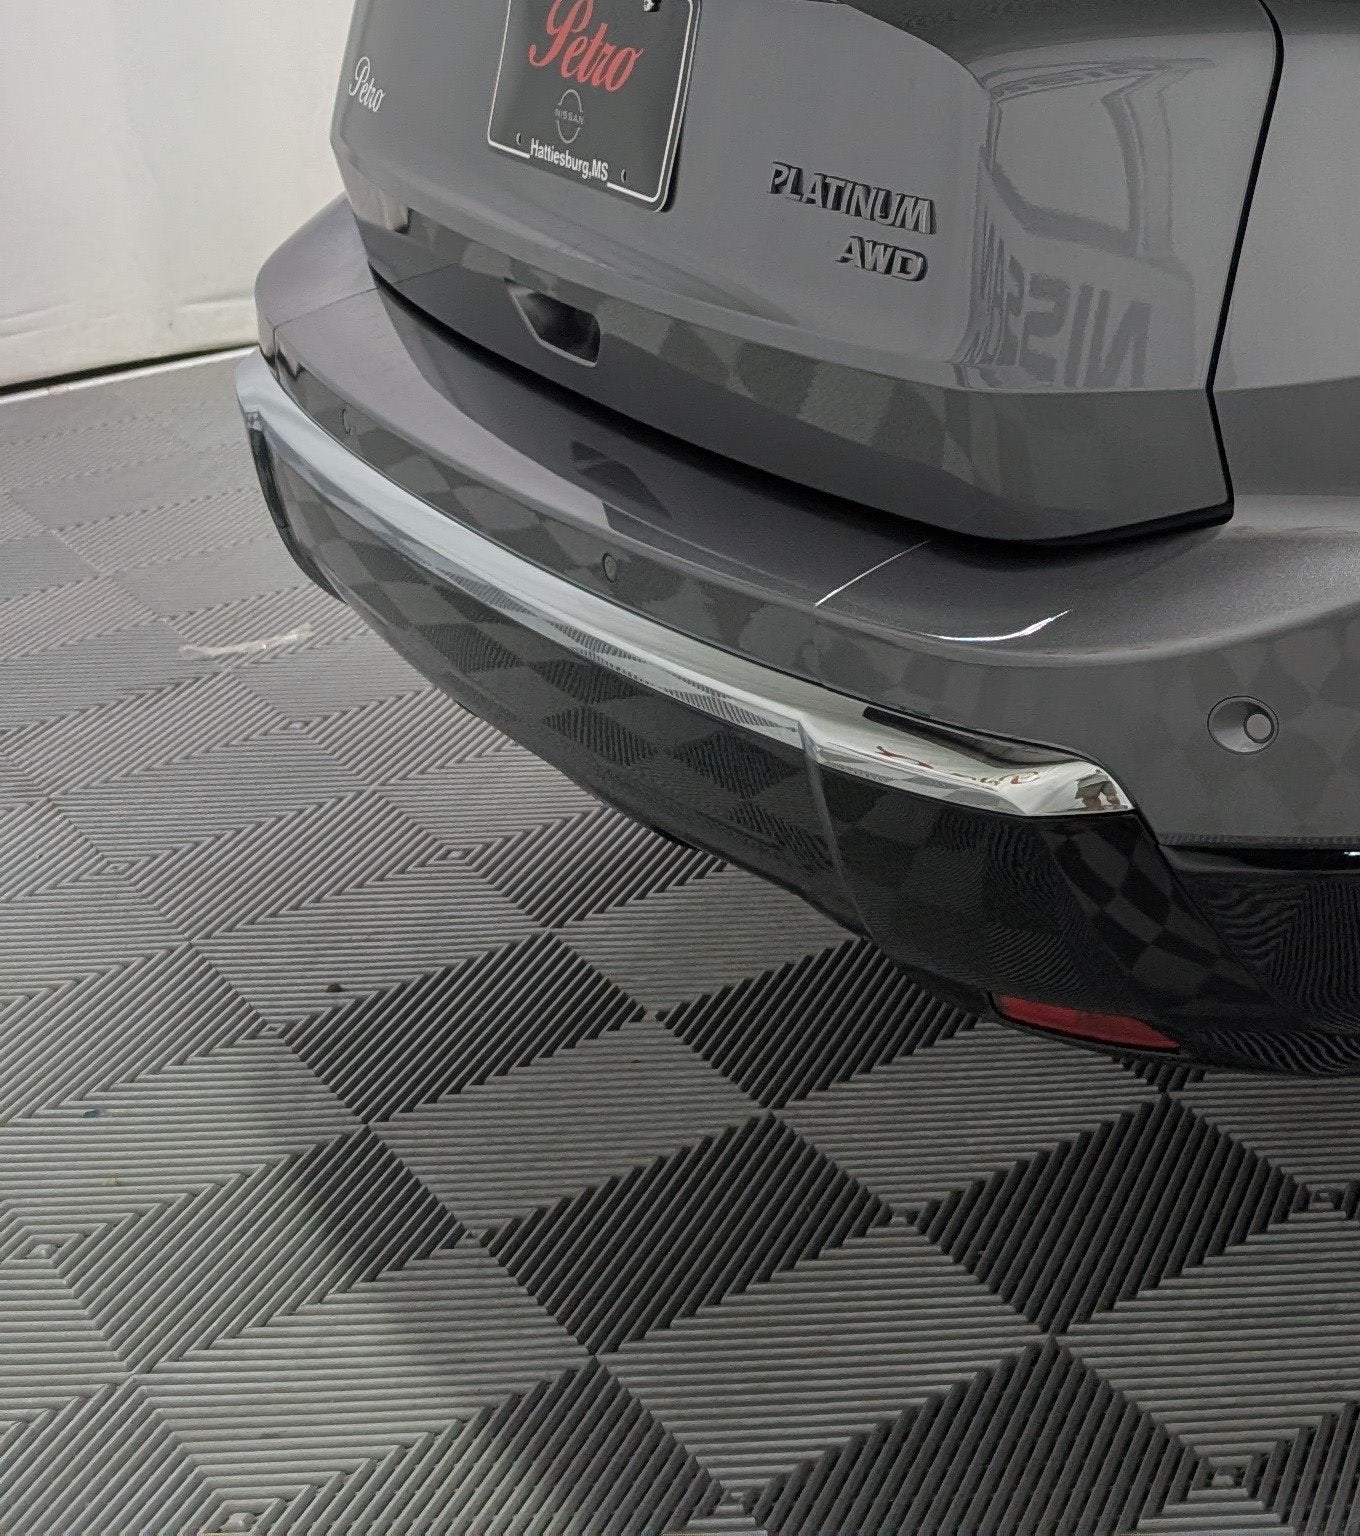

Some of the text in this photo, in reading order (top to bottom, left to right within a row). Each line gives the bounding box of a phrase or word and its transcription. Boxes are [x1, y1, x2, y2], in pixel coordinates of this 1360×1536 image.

[349, 56, 386, 113] Petro
[555, 107, 586, 125] NISSAN
[769, 161, 938, 236] PLATINUM
[836, 235, 929, 282] AWD
